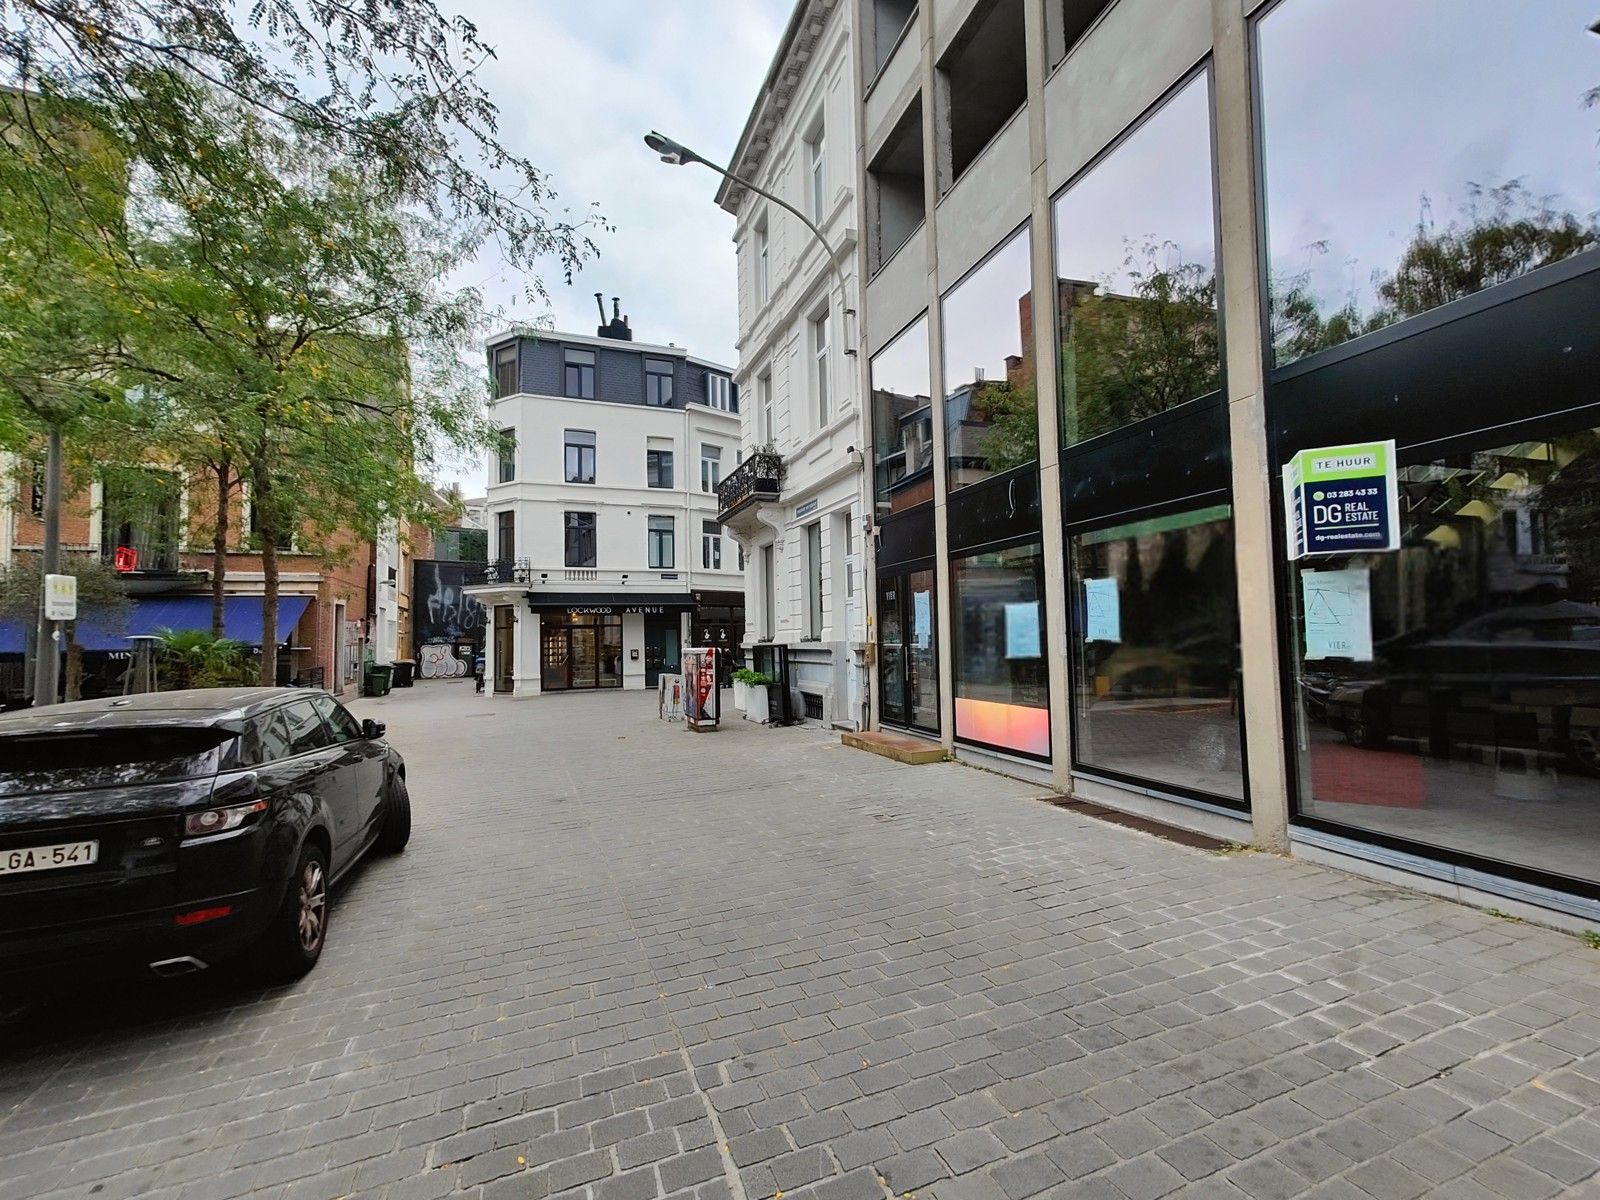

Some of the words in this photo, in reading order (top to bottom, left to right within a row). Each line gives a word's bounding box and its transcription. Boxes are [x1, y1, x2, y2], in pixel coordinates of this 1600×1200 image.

[1317, 461, 1331, 469] TE
[1336, 457, 1371, 468] HUUR
[1326, 491, 1337, 499] 03
[1344, 501, 1369, 512] REAL
[1313, 504, 1342, 524] DG
[1345, 510, 1379, 523] ESTATE
[1315, 532, 1381, 541] dg-realestate.com
